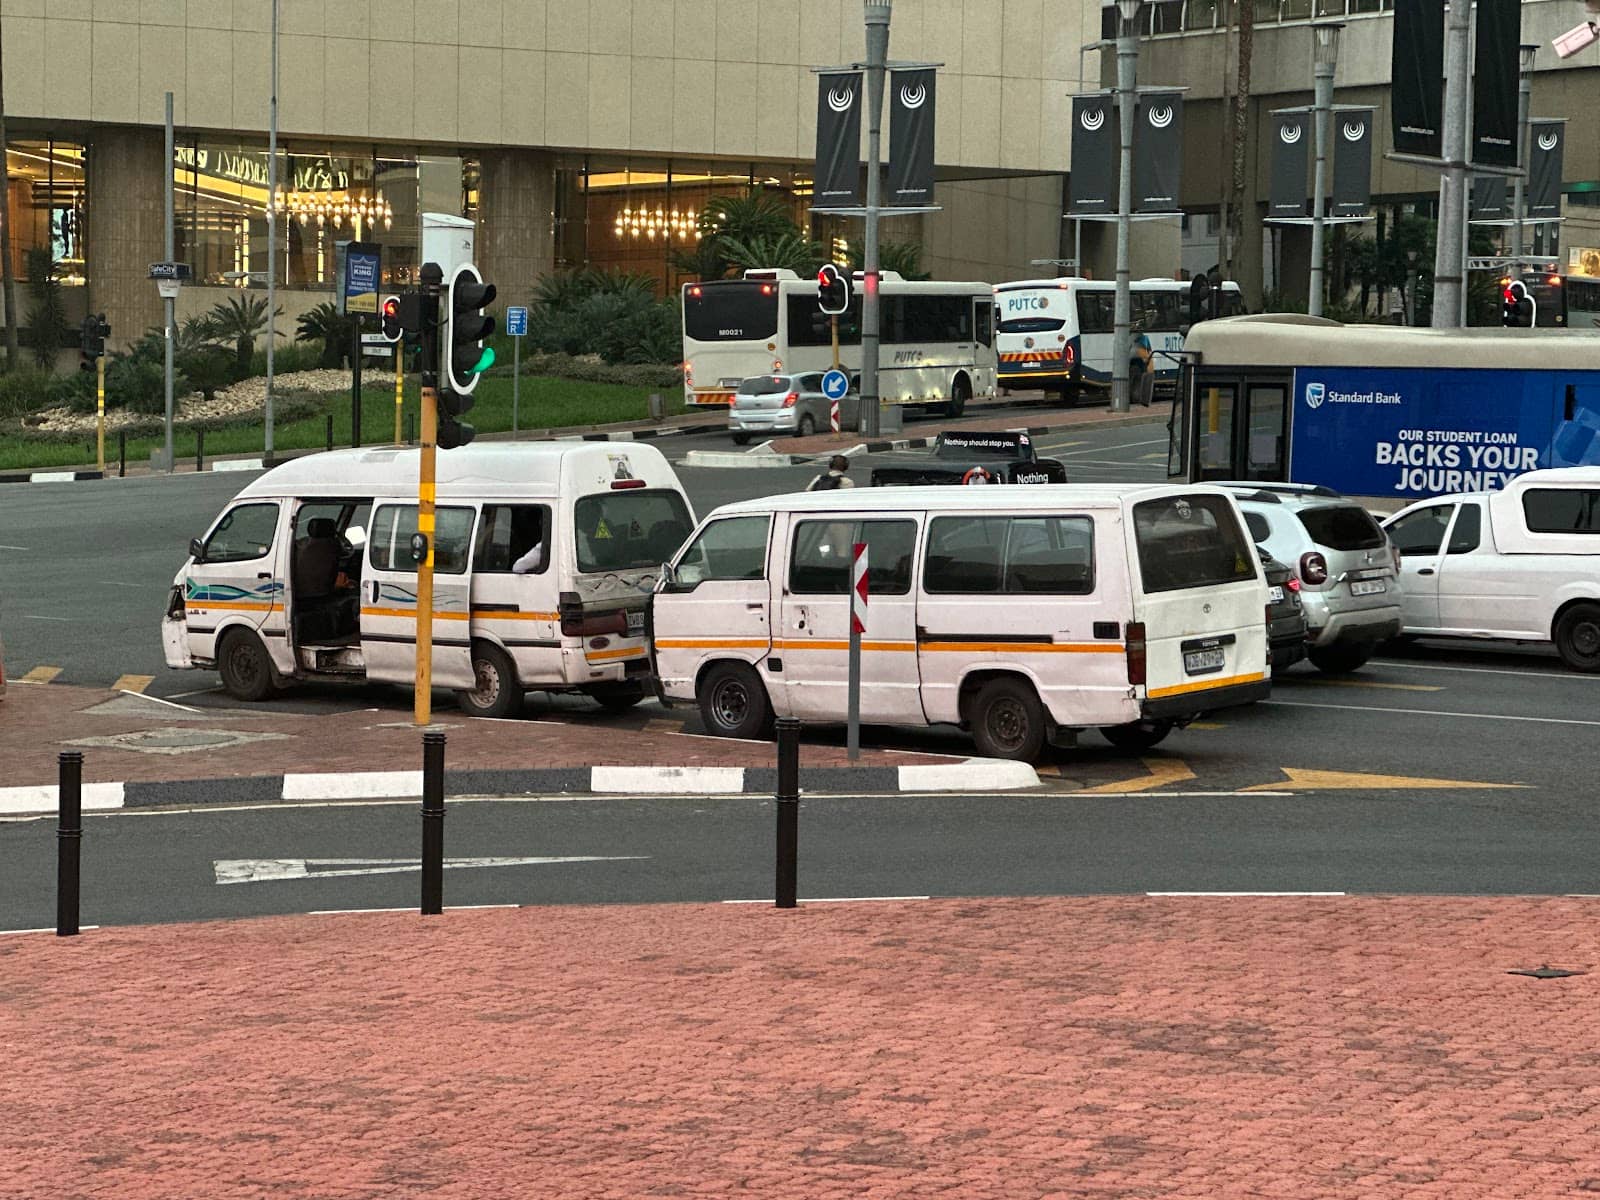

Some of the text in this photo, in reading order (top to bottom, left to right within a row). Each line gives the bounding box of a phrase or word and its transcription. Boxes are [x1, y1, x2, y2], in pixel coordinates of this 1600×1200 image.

[1165, 336, 1184, 351] PUTC
[1328, 391, 1402, 405] Standard Bank
[944, 438, 1016, 449] Nothing should stop you.
[1398, 429, 1518, 445] OUR STUDENT LOAN
[1376, 442, 1539, 471] BACKS YOUR
[1016, 471, 1049, 485] Nothing
[1394, 467, 1517, 493] JOURNEY
